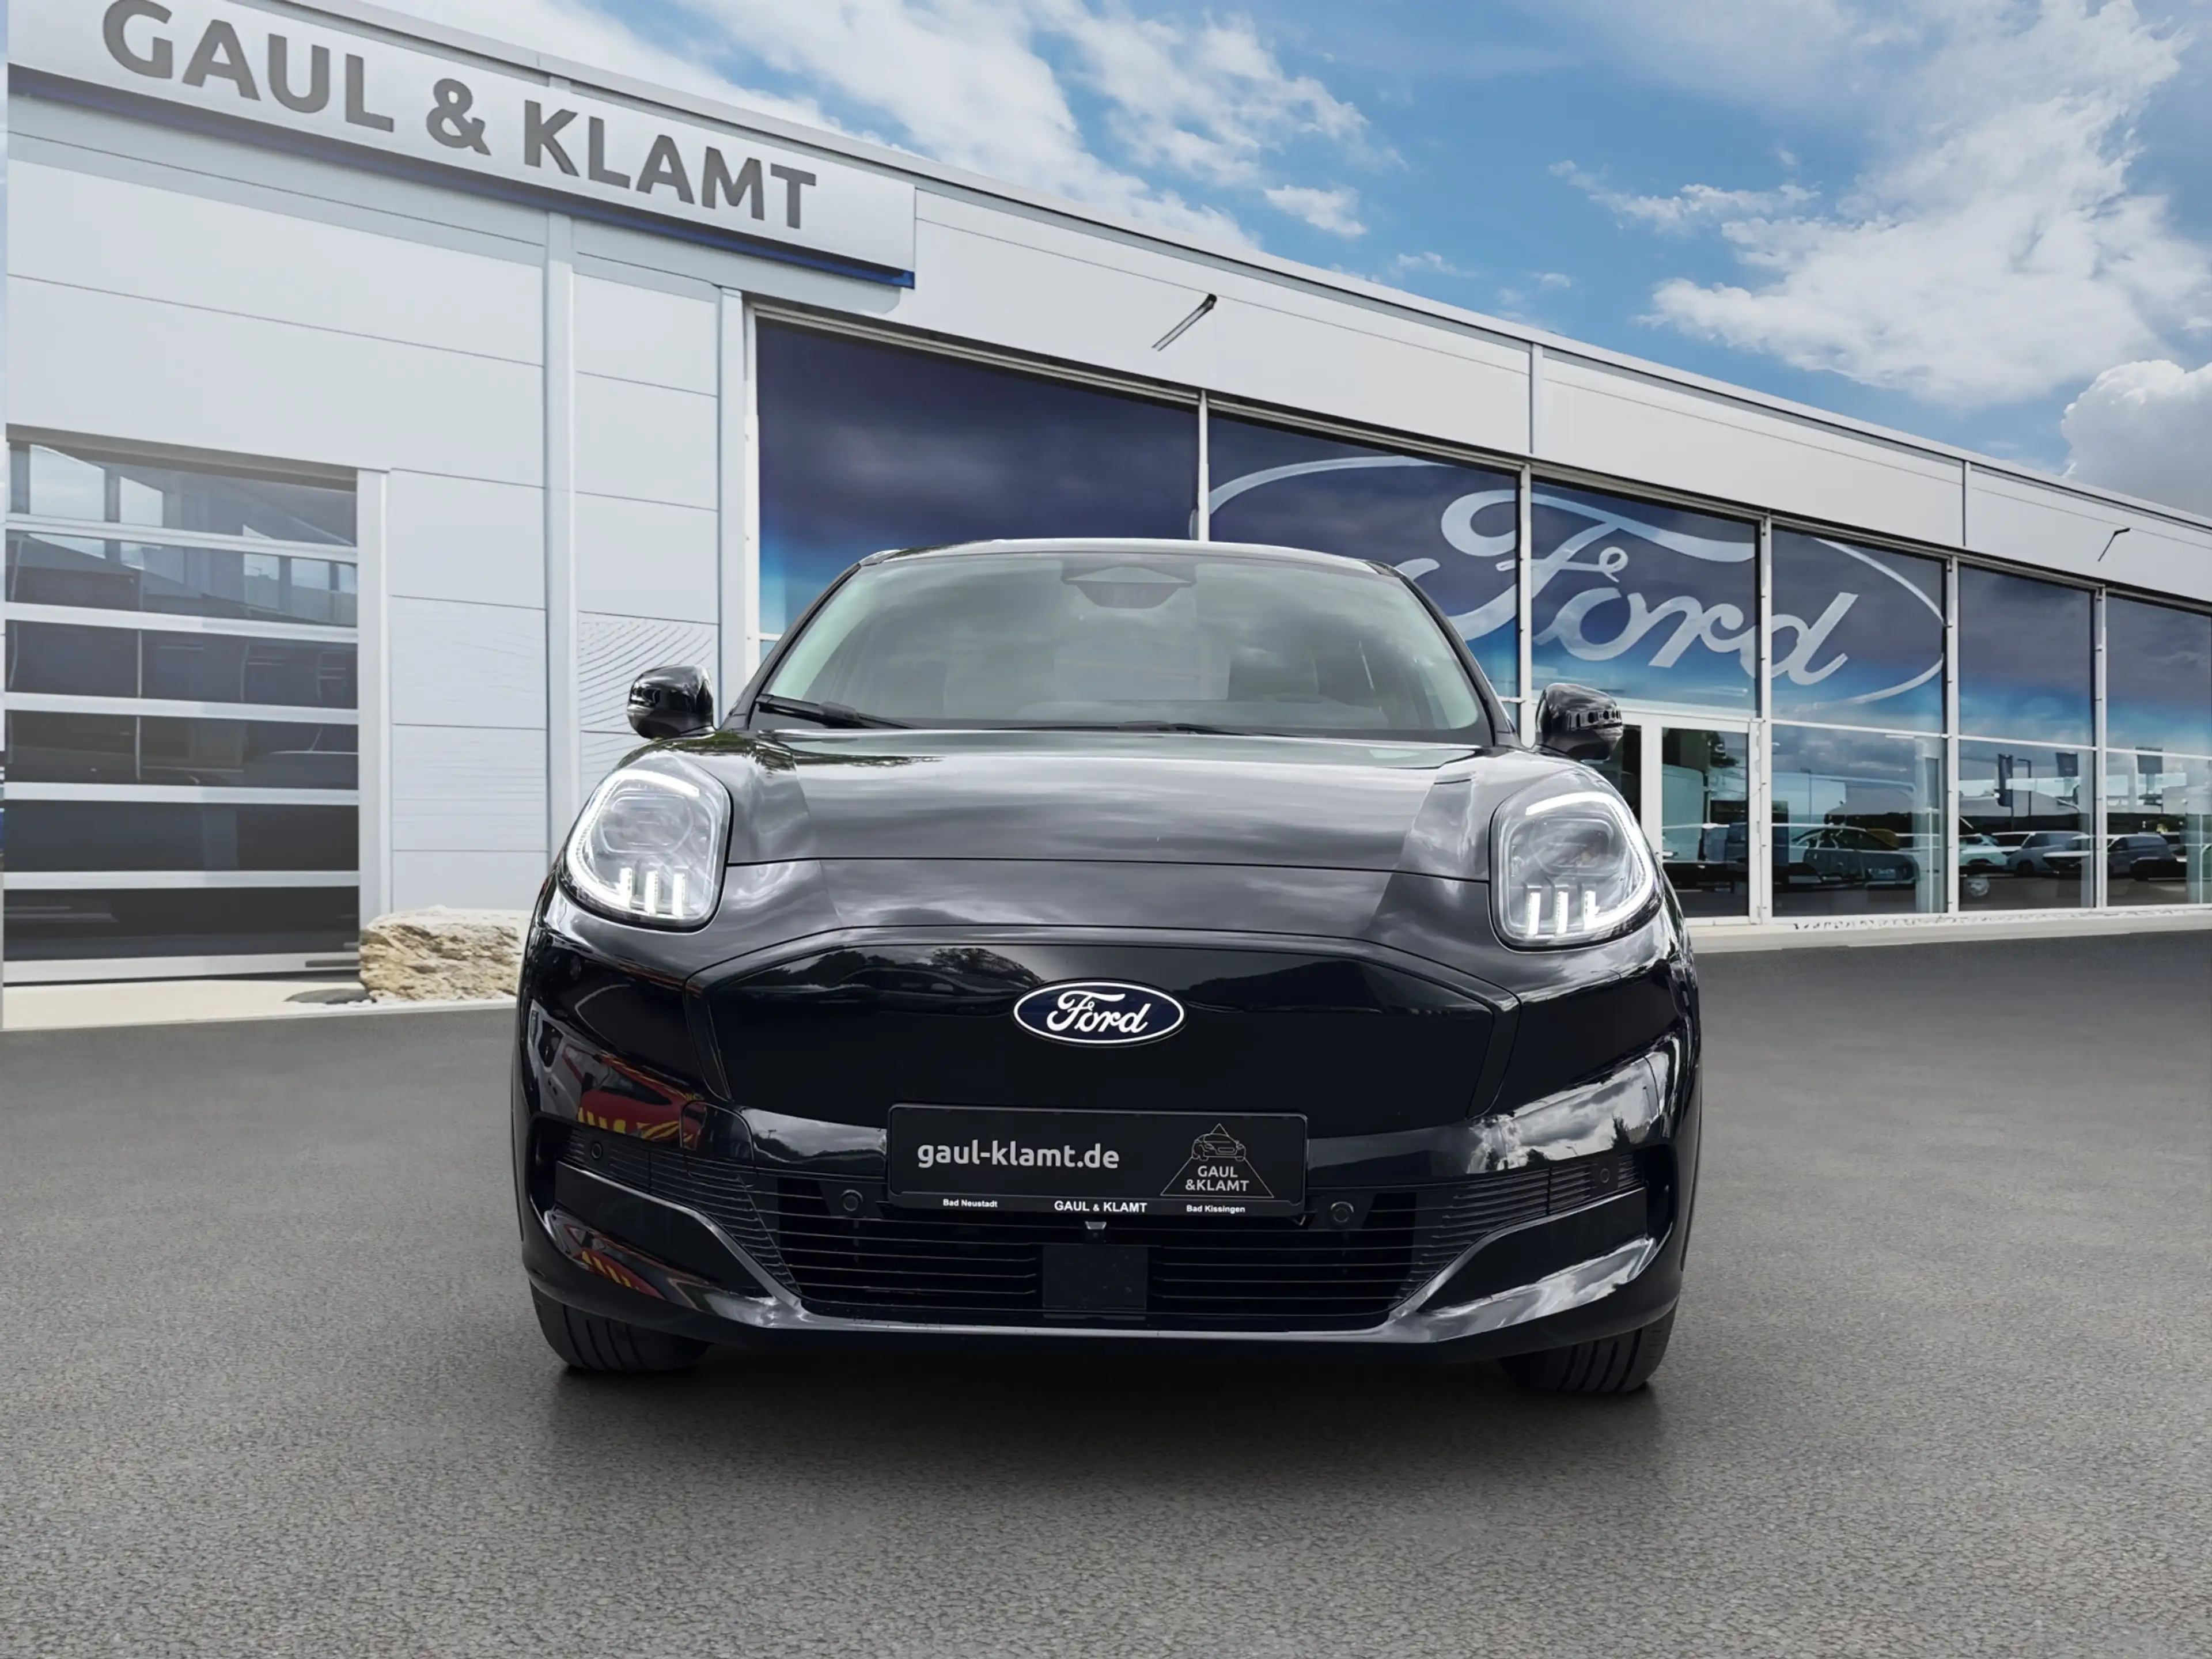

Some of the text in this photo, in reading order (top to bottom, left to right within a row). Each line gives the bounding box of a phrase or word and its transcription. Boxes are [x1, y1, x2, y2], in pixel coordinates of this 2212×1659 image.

[103, 0, 817, 229] GAUL & KLAMT
[1393, 489, 1859, 685] Ford
[1046, 990, 1152, 1033] Ford
[917, 1139, 1119, 1169] gaul-klamt.de
[1198, 1165, 1238, 1178] GAUL
[1185, 1179, 1249, 1192] &KLAMT
[942, 1198, 998, 1208] Bad Neustadt
[1054, 1200, 1148, 1213] GAUL & KLAMT
[1186, 1204, 1245, 1214] Bad Kissingen
